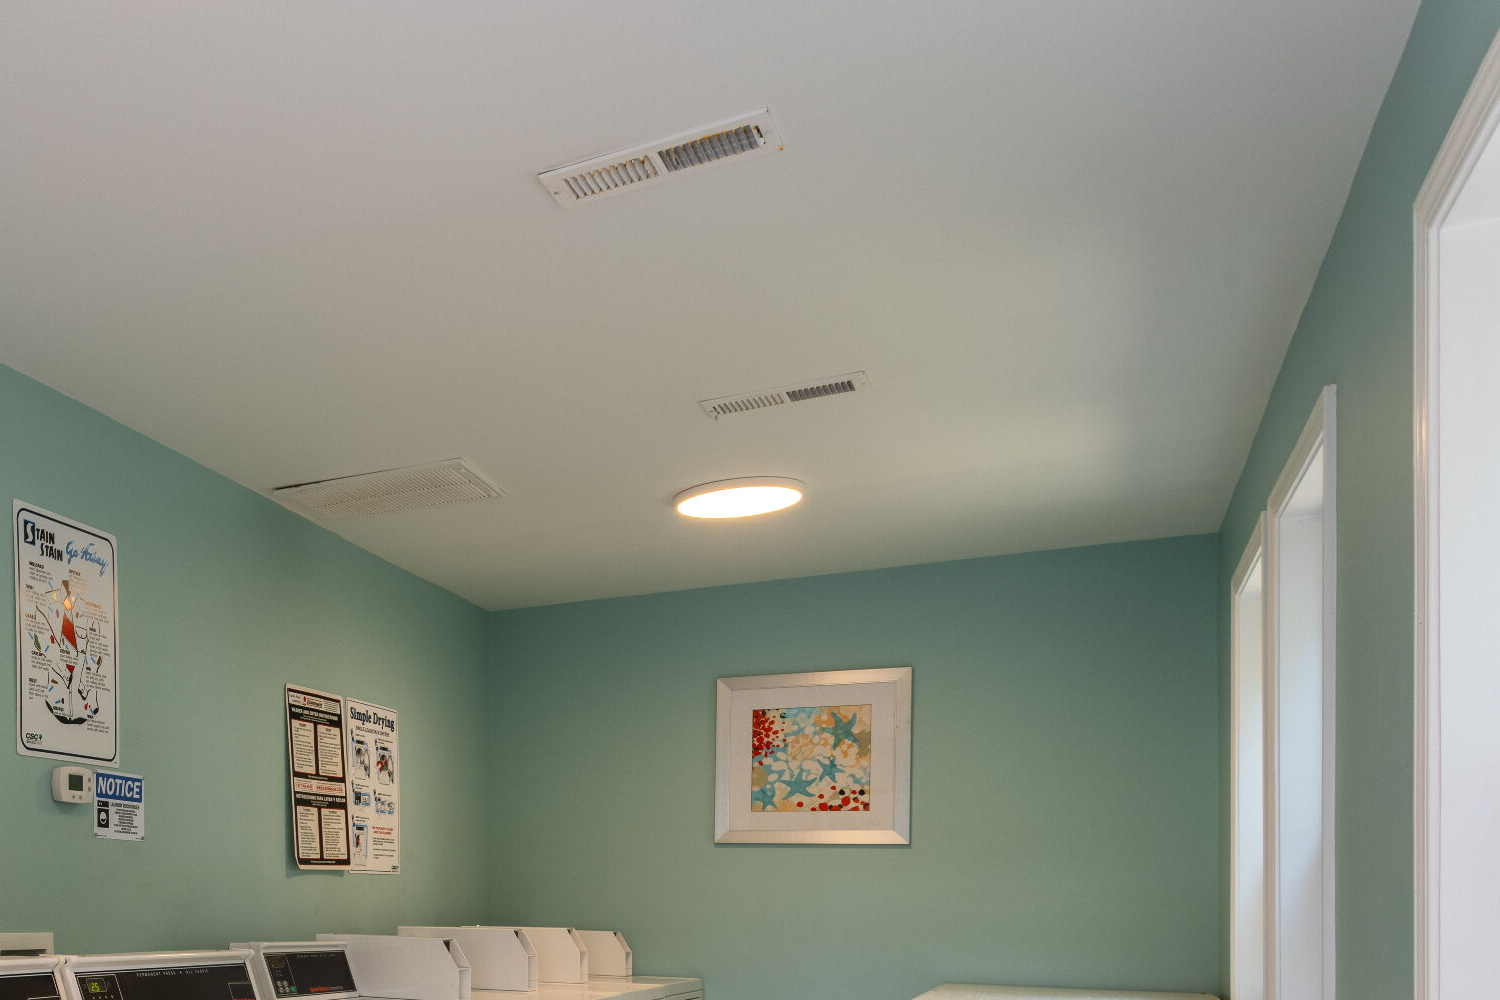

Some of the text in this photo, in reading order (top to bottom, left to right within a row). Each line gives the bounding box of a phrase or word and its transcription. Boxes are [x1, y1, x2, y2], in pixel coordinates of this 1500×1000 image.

[40, 543, 63, 562] STAIN
[65, 540, 79, 565] Go
[80, 543, 107, 577] Away
[350, 707, 372, 726] Simple
[372, 712, 395, 732] Drying
[97, 776, 141, 799] NOTICE
